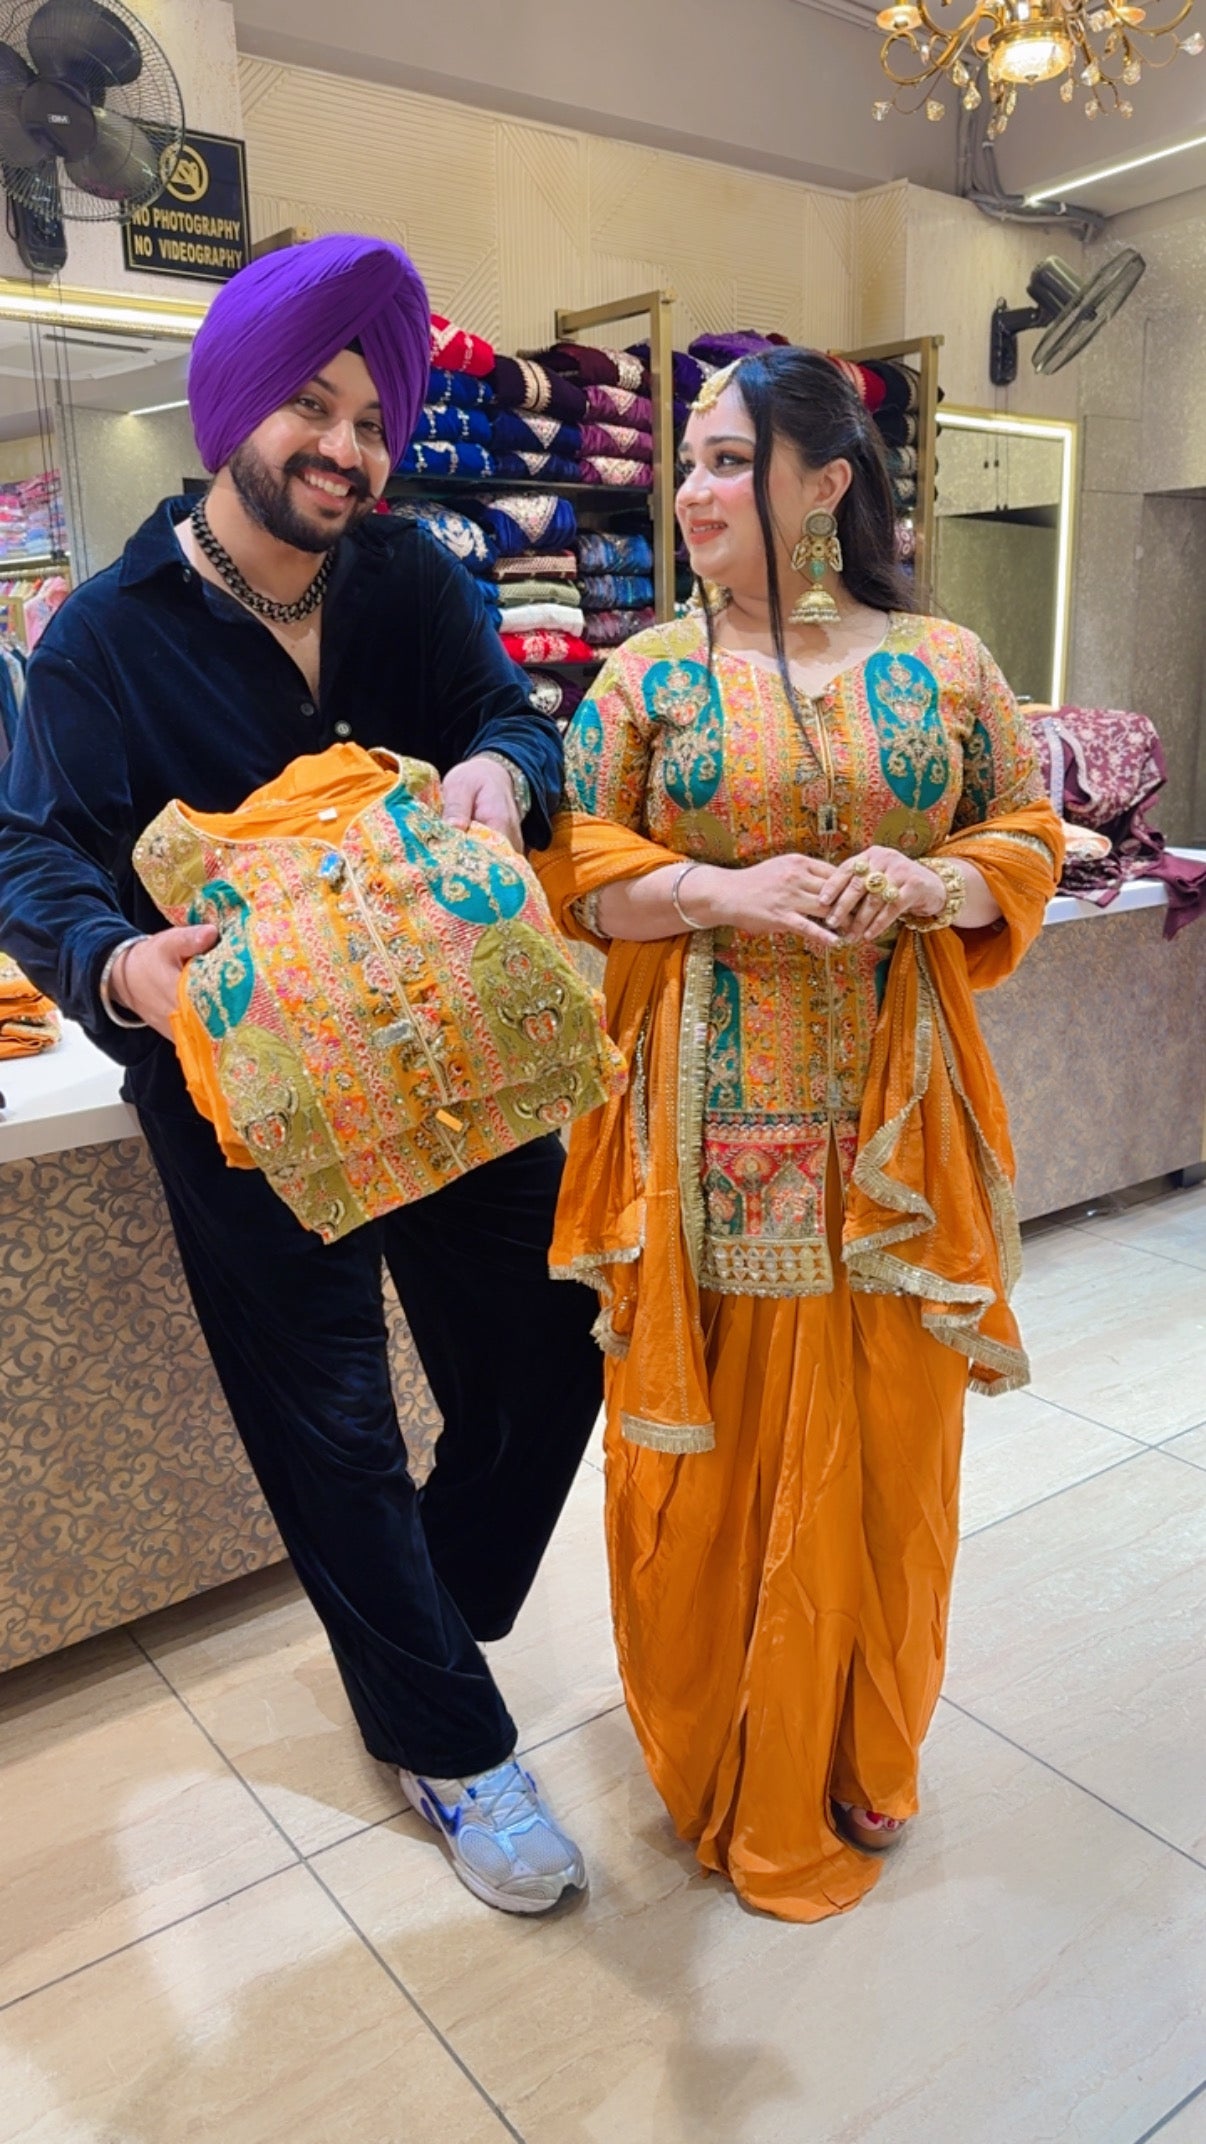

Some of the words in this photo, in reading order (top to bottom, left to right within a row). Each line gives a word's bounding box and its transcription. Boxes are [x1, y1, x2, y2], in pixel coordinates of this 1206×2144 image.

[152, 207, 241, 241] PHOTOGRAPHY
[133, 233, 153, 257] NO
[158, 237, 243, 269] VIDEOGRAPHY
